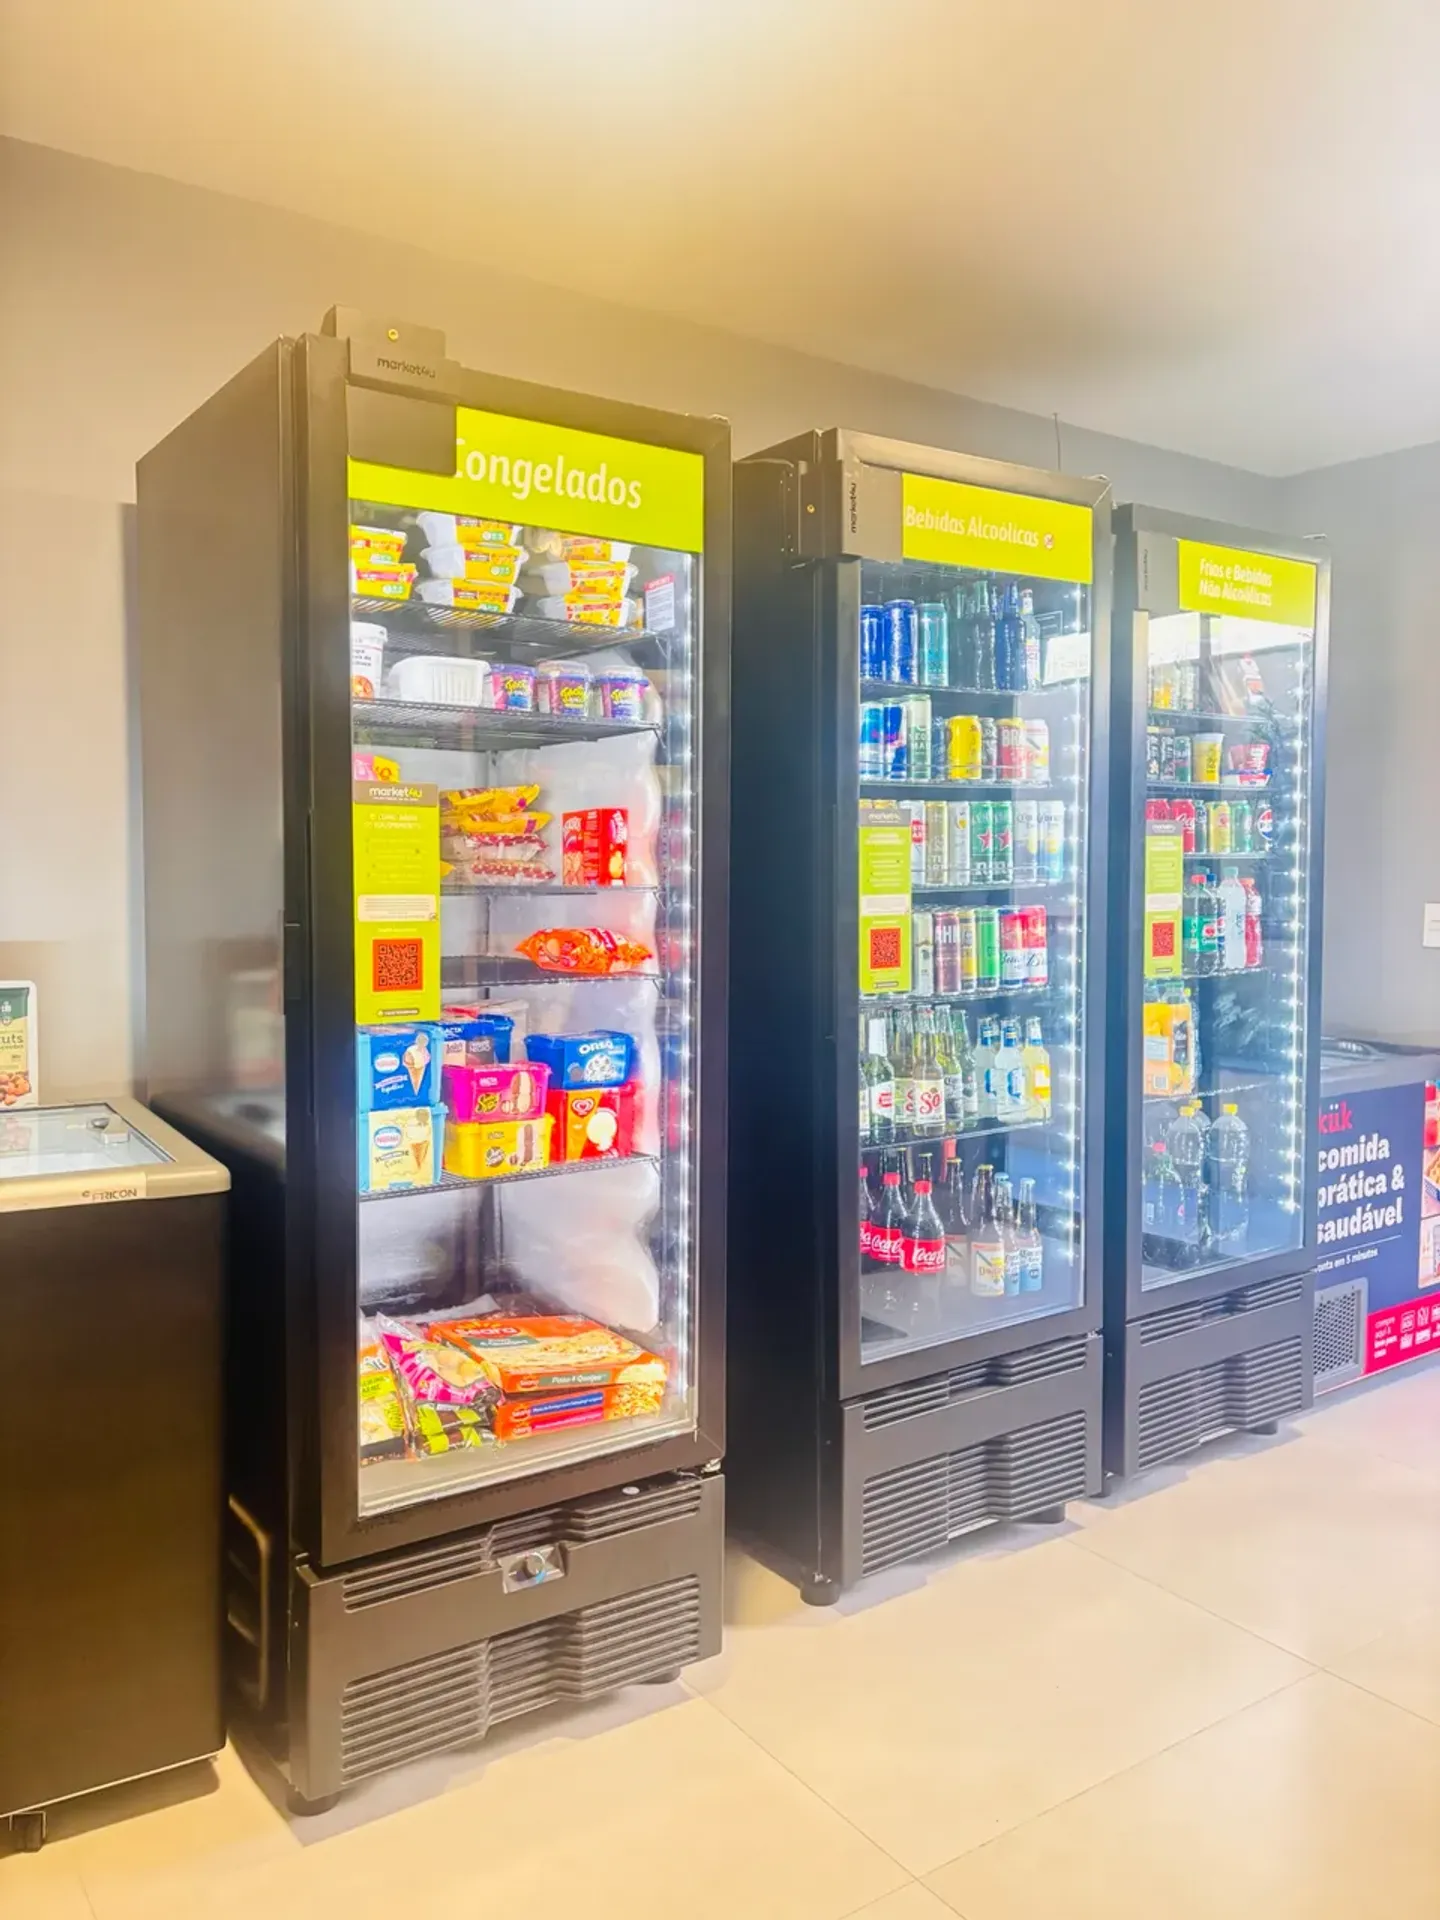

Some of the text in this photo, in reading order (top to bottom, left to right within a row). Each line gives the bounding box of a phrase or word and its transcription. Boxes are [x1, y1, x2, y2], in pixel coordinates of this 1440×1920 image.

[905, 504, 1039, 548] Bebidas Alcoólicas
[1199, 557, 1273, 589] Frios e Bebidas
[1198, 579, 1221, 599] Não
[368, 786, 423, 799] market4u
[1318, 1133, 1390, 1173] comida
[1391, 1164, 1405, 1191] &
